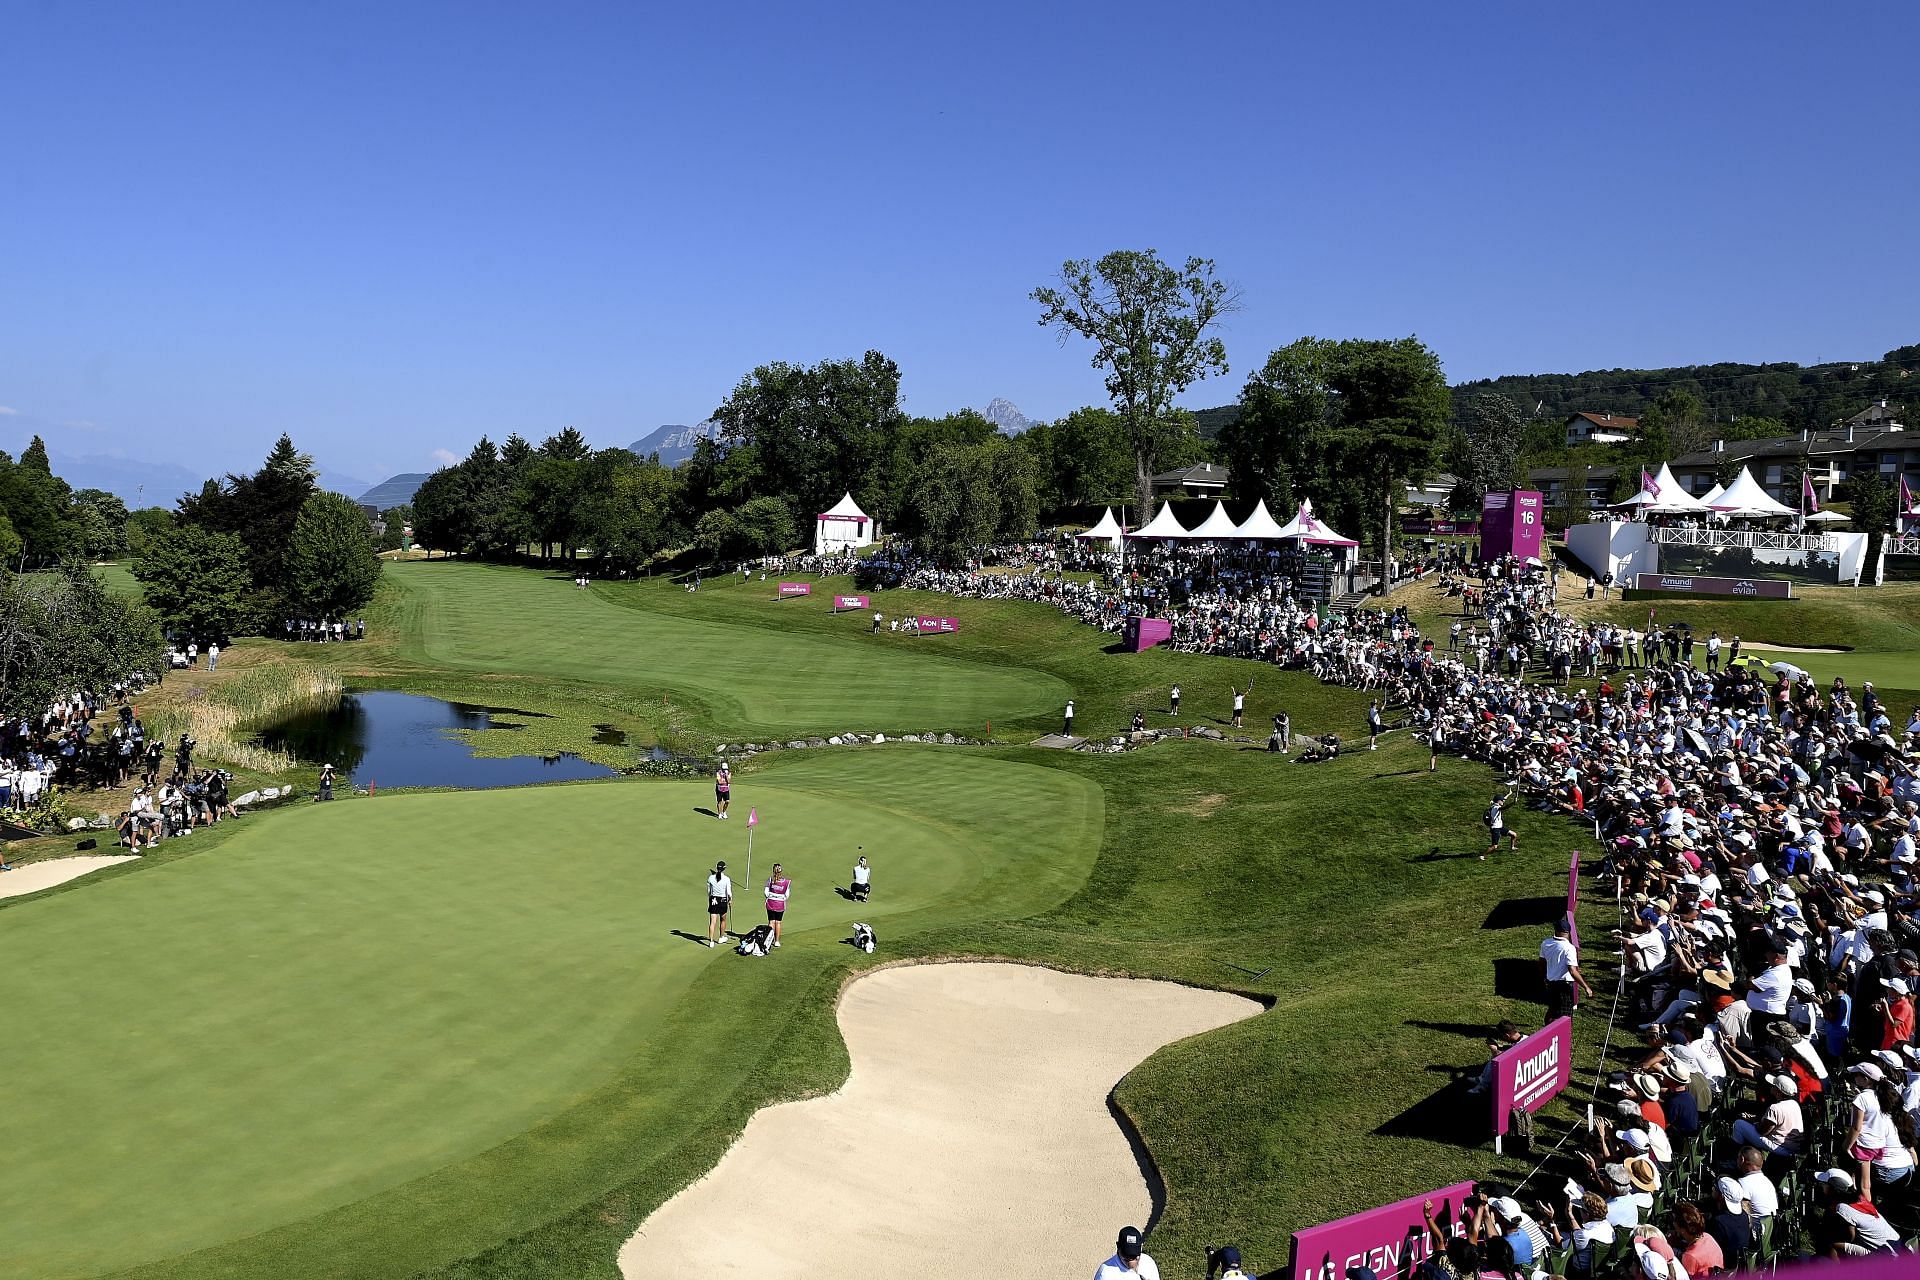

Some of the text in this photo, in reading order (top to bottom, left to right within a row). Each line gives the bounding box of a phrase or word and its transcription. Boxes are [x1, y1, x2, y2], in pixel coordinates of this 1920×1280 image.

[1521, 511, 1534, 525] 16
[1661, 577, 1692, 586] Amundi
[1733, 586, 1757, 595] evian
[922, 619, 937, 627] AON
[1514, 1035, 1558, 1092] Amundi
